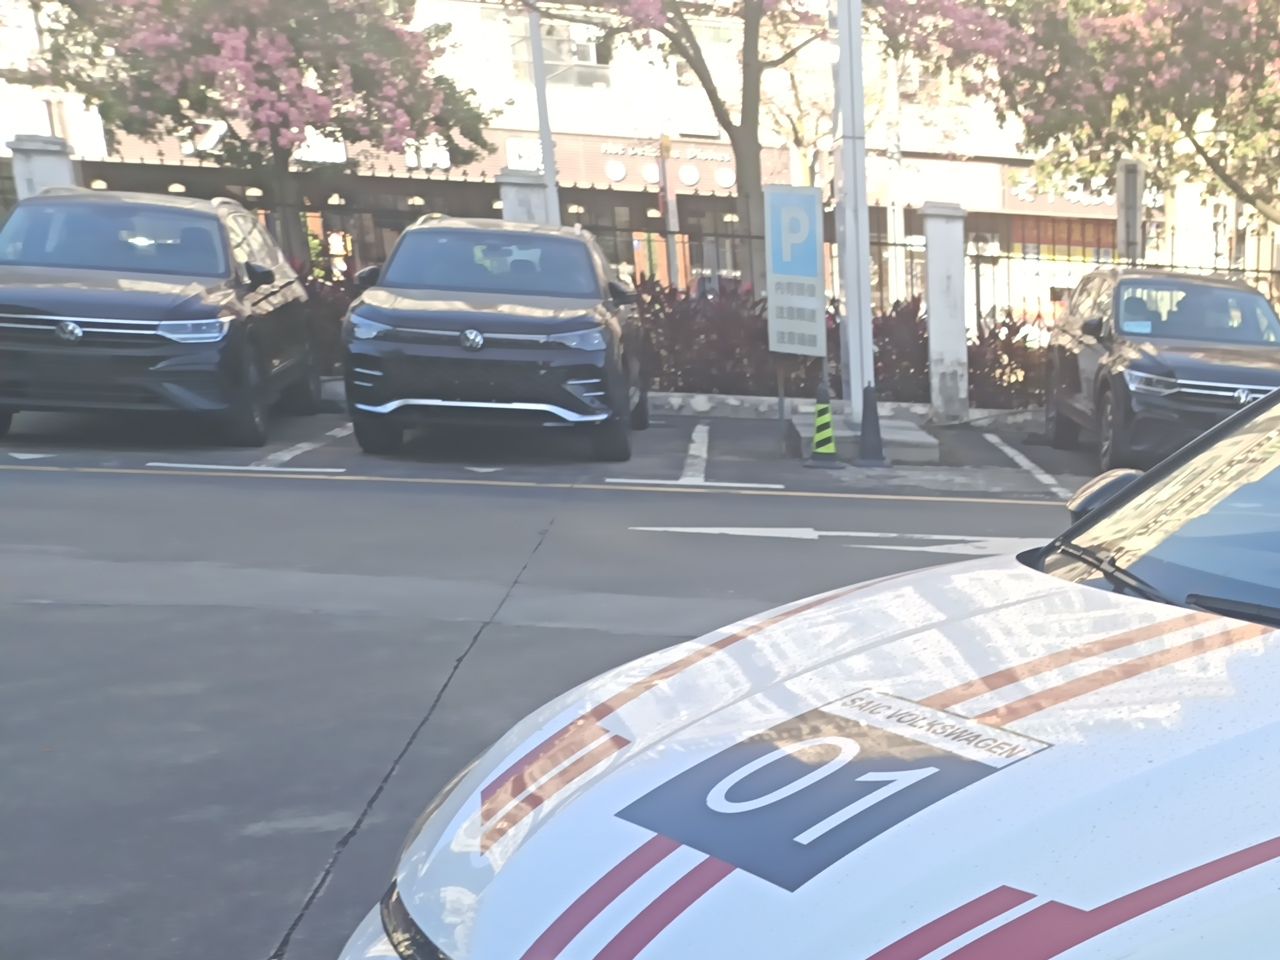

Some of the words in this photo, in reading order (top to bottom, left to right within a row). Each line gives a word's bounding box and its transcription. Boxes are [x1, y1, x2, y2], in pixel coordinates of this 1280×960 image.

[780, 206, 810, 263] P
[841, 696, 892, 715] SAIC
[886, 708, 1026, 759] VOLKSWAGEN
[706, 736, 940, 846] 01
